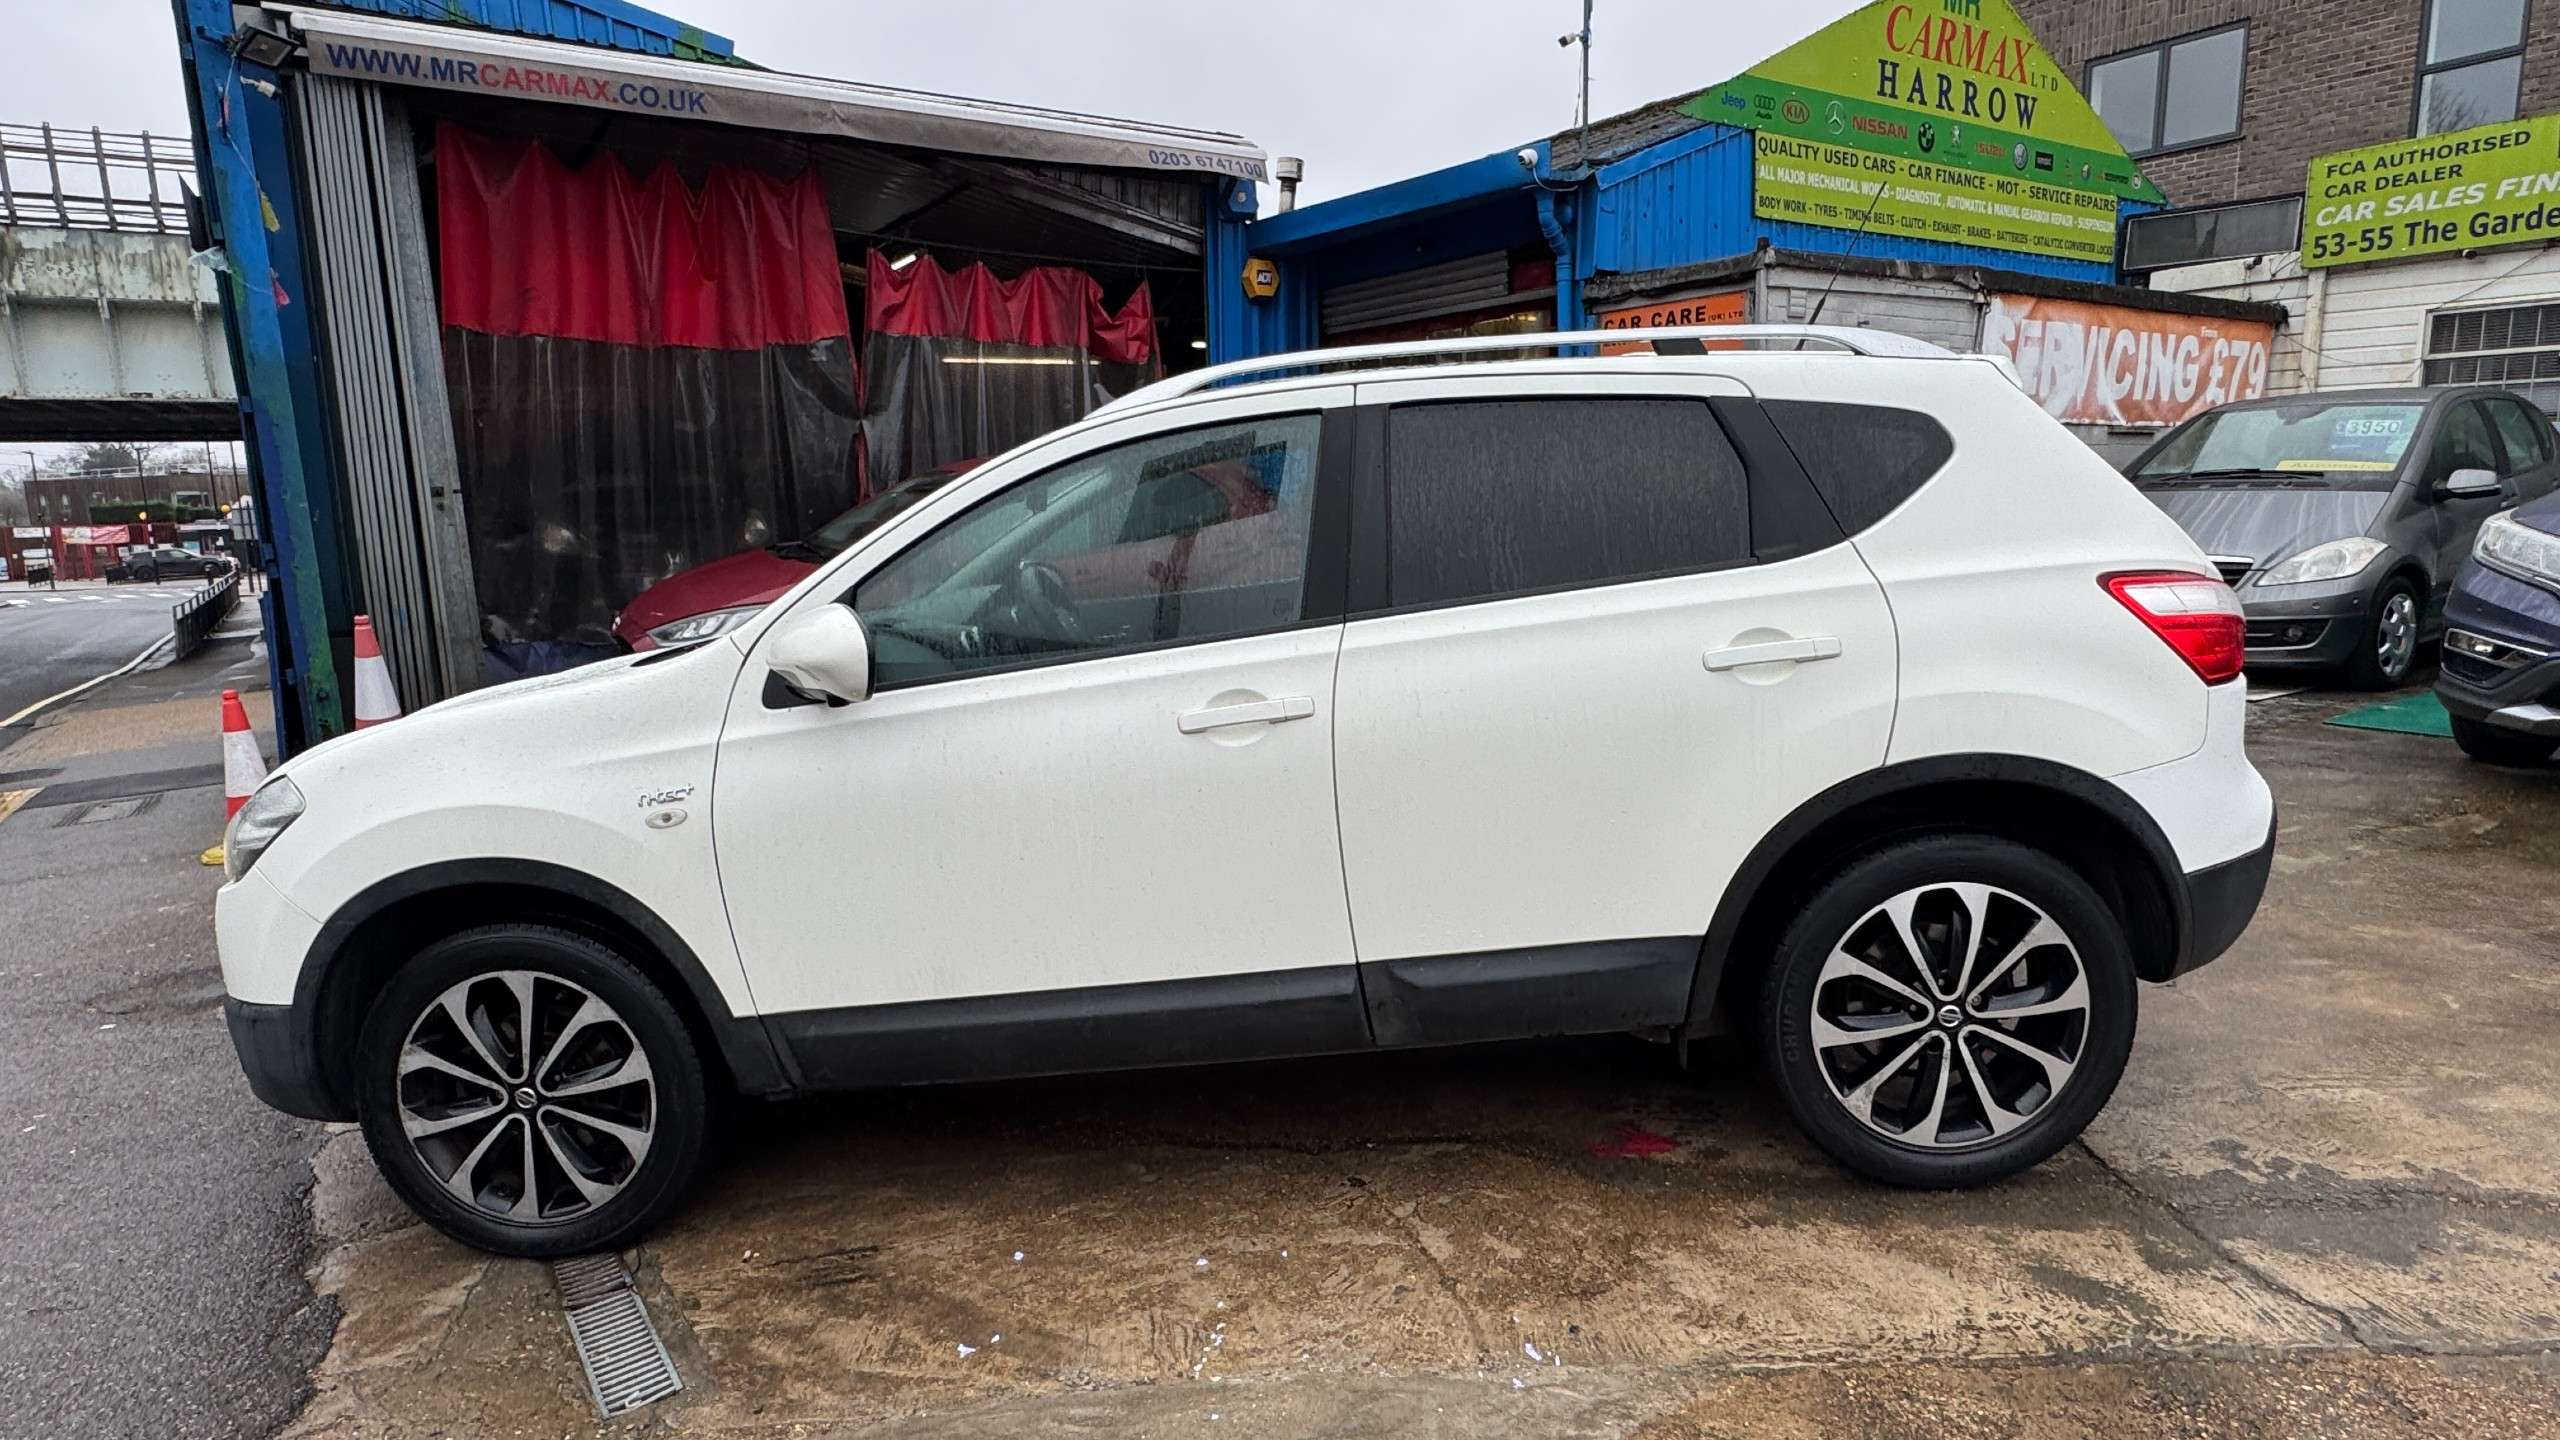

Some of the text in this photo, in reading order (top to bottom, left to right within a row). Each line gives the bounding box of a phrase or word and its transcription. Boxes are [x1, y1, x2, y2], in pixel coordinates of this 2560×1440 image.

[1886, 5, 2058, 92] CARMAX LTD
[326, 43, 709, 115] WWW.MRCARMAX.CO.UK
[1877, 59, 2039, 130] HARROW
[1721, 91, 1746, 111] Jeep
[1786, 104, 1805, 121] KIA
[1852, 114, 1909, 140] NISSAN
[1149, 150, 1263, 178] 0203 6747100
[1758, 136, 2116, 212] QUALITY USED CARS CAR FINANCE MOT SERVICE REPAIRS
[2326, 159, 2366, 179] FCA
[2373, 130, 2531, 171] AUTHORISED
[1759, 164, 1774, 181] ALL
[1777, 167, 1807, 184] MAJOR
[1808, 172, 1860, 193] MECHANICAL
[2315, 170, 2560, 227] CAR SALES FIN
[2324, 163, 2464, 199] CAR DEALER
[1759, 195, 1780, 209] BODY
[1784, 199, 1807, 213] WORK
[1814, 203, 1838, 218] TYRES
[1844, 207, 1873, 223] TIMING
[1873, 211, 1895, 226] BELTS
[1901, 216, 1926, 229] CLUTCH
[1932, 220, 1962, 235] EXHAUST
[2312, 225, 2394, 260] 53-55
[2404, 218, 2458, 247] The
[1650, 304, 1707, 327] CARE
[2207, 337, 2267, 405] £79
